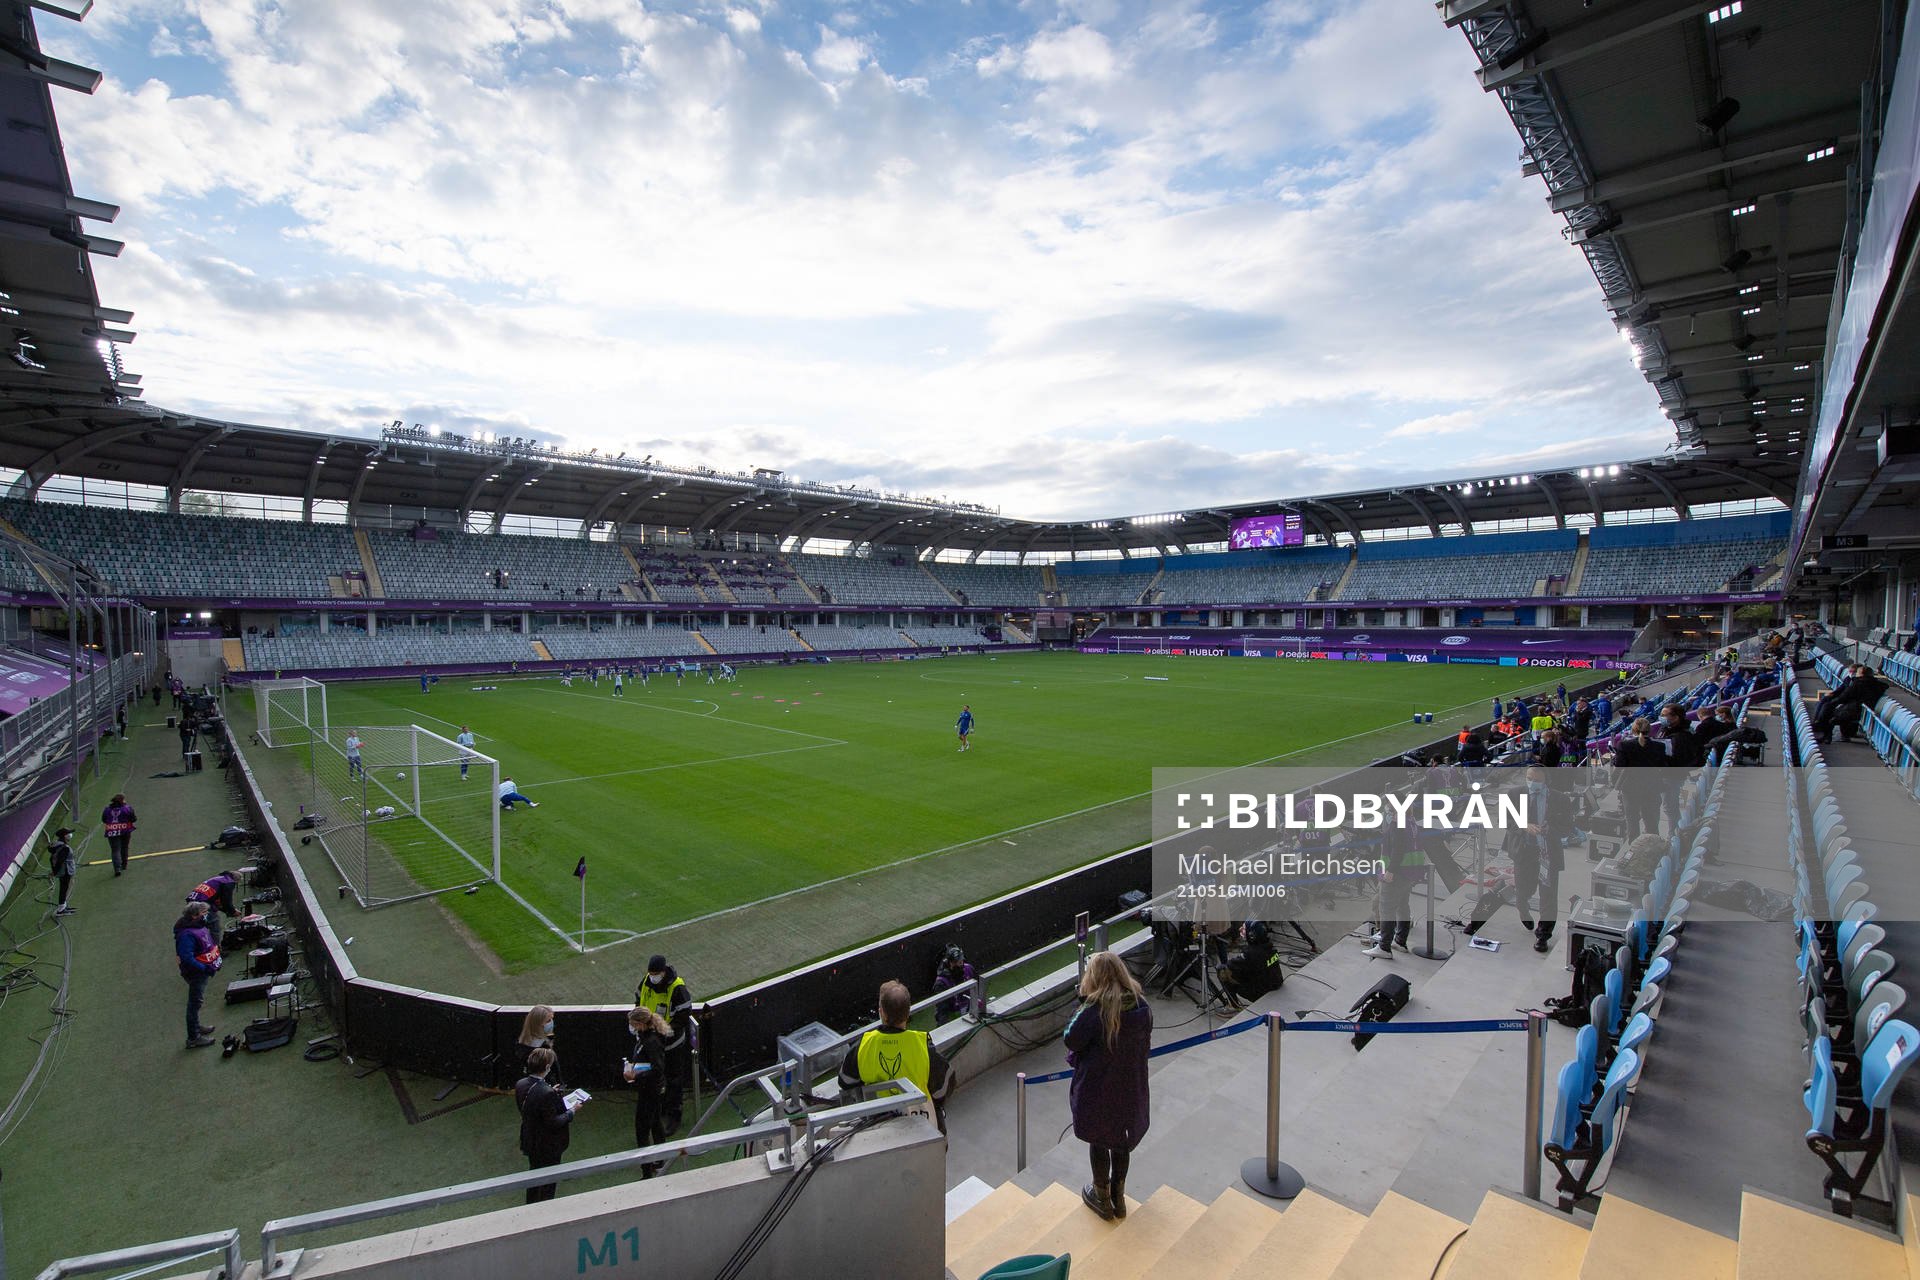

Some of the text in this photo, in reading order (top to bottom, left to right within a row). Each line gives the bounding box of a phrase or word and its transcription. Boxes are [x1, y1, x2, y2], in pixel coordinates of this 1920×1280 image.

[1836, 536, 1854, 547] M3
[1189, 648, 1224, 656] HUBLOT
[1405, 654, 1428, 662] VISA
[1530, 658, 1566, 667] pepsi
[577, 1226, 640, 1274] M1
